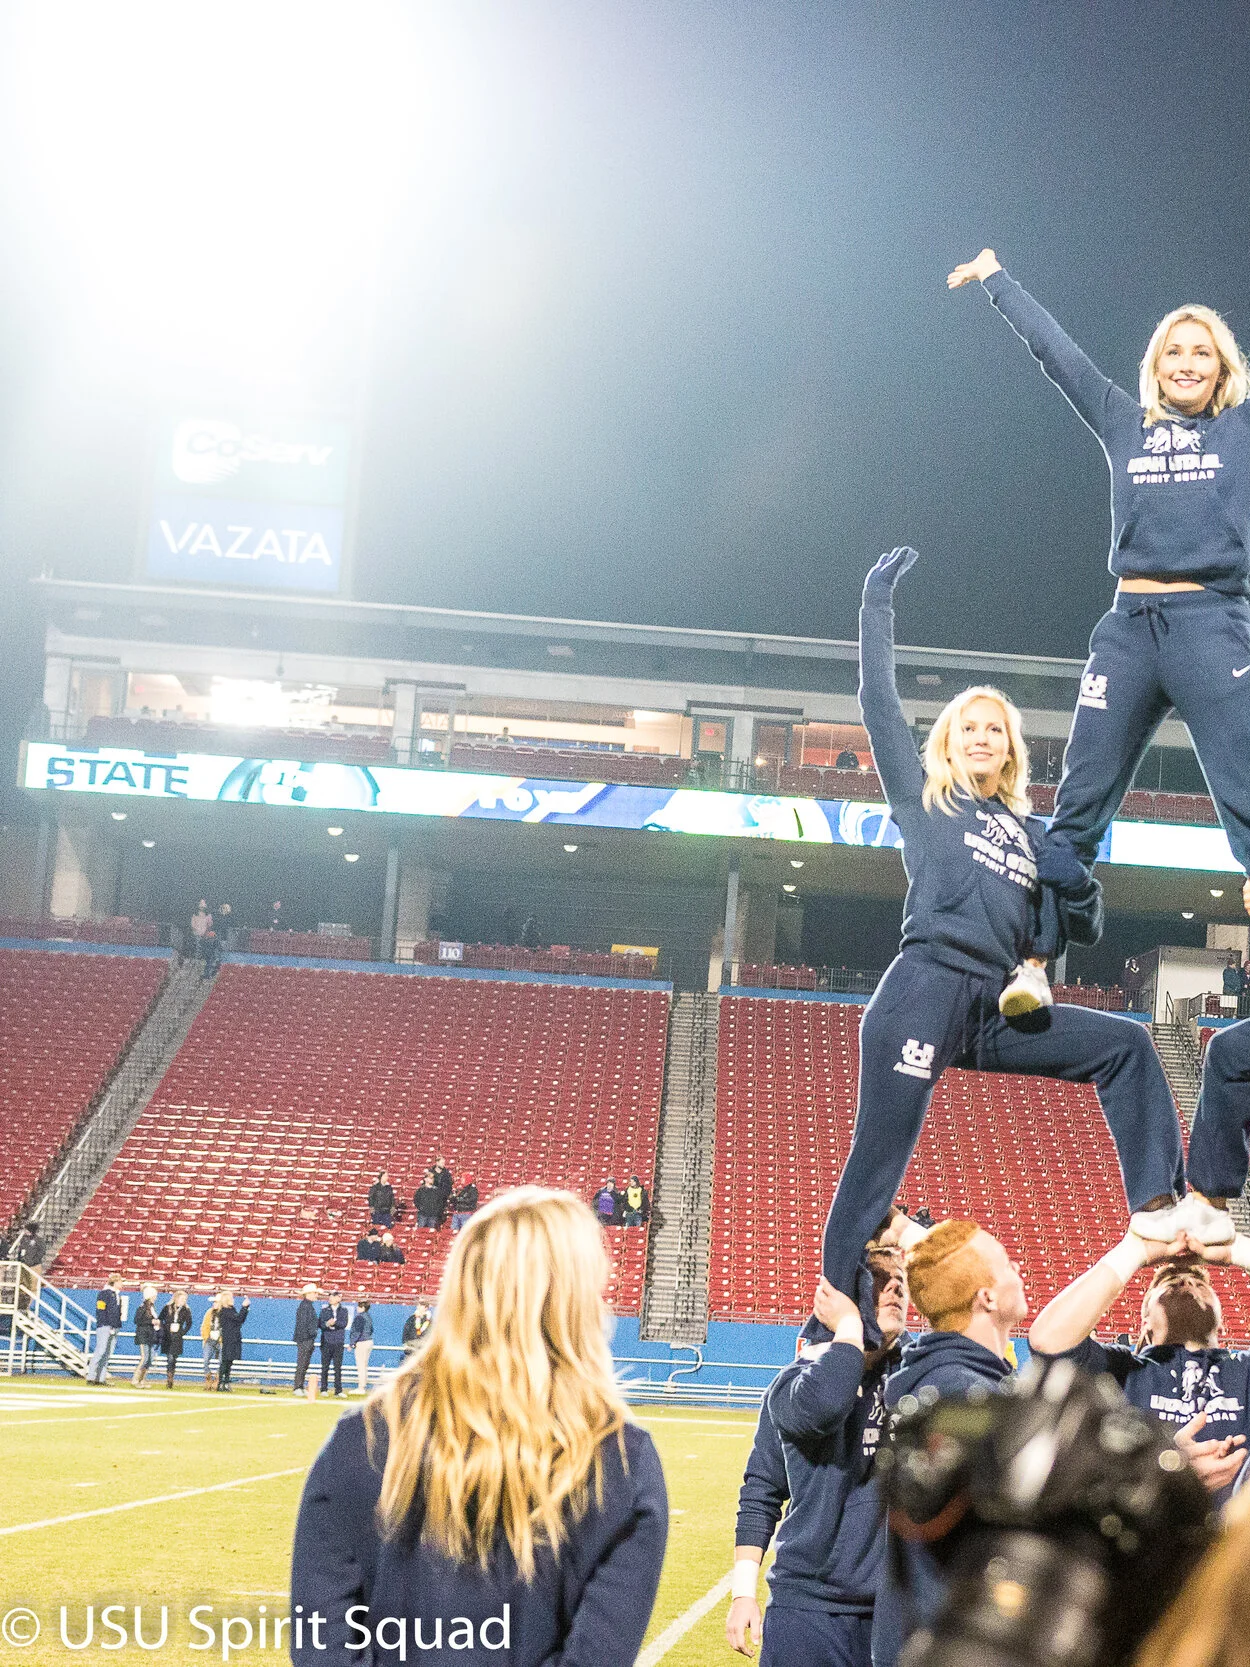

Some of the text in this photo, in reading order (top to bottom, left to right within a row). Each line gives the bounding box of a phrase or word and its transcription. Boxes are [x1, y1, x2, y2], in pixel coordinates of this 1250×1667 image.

[1132, 473, 1170, 484] SPIRIT
[159, 519, 332, 566] VAZATA
[46, 757, 189, 798] STATE
